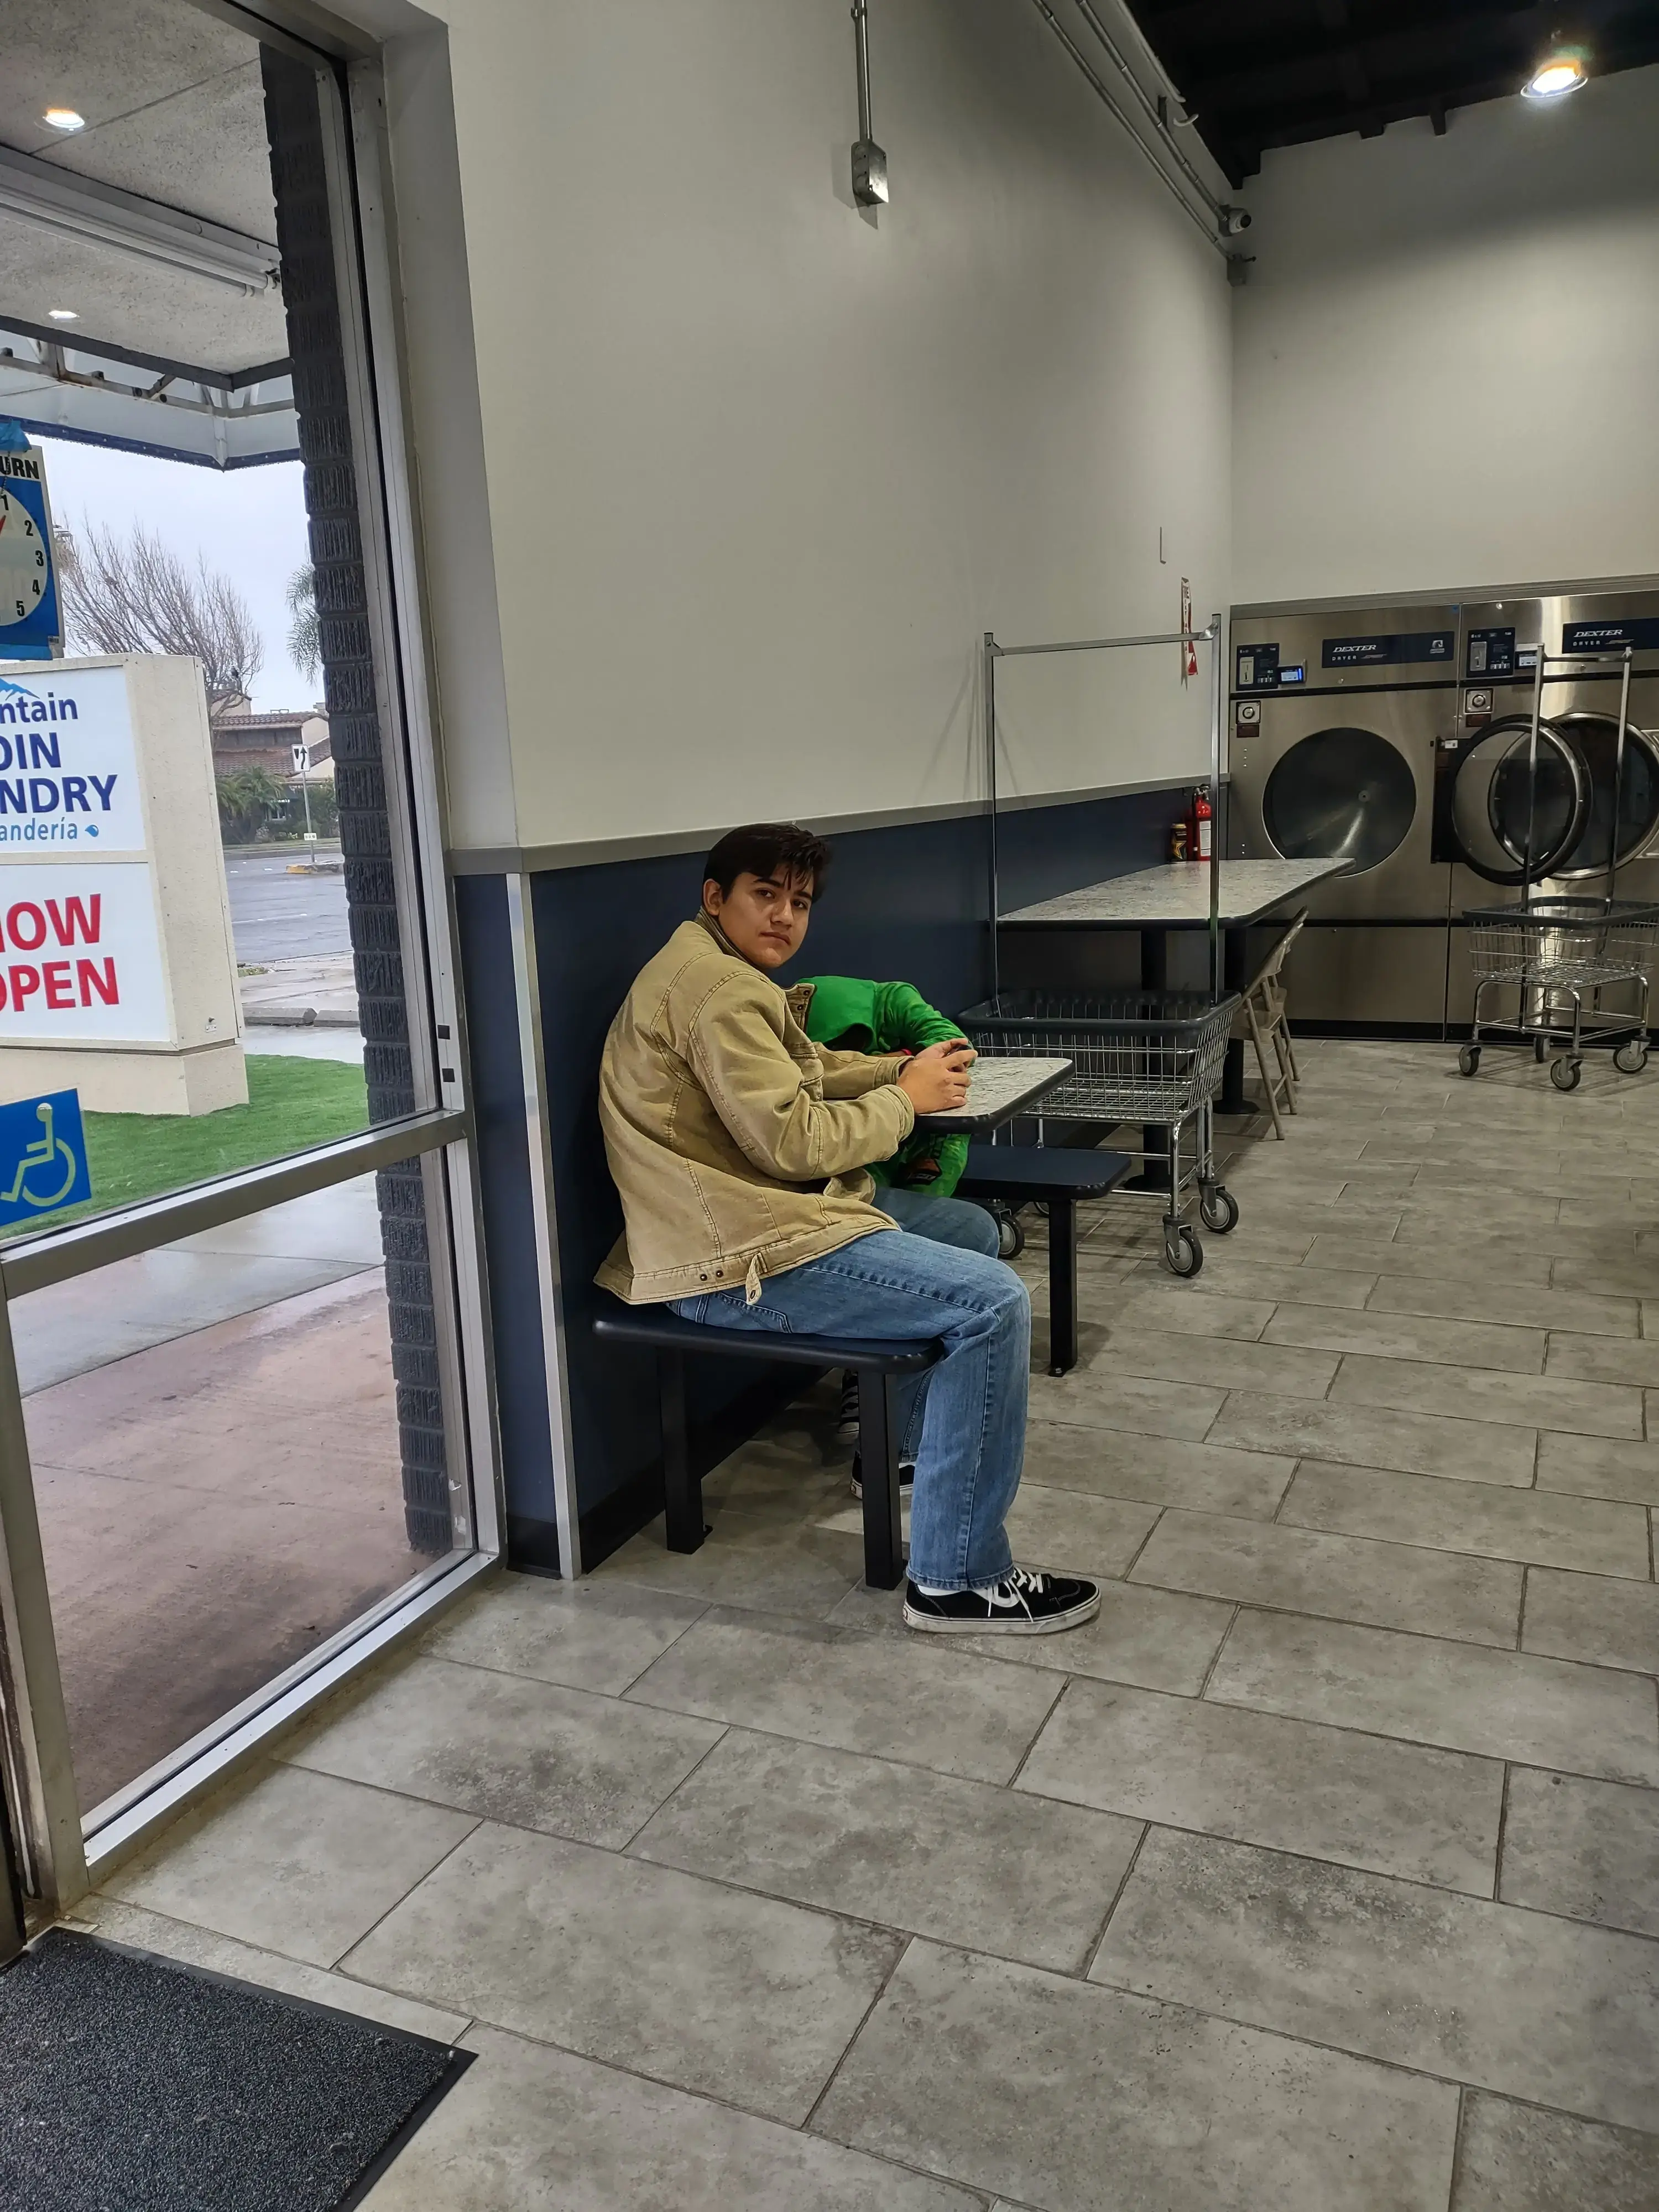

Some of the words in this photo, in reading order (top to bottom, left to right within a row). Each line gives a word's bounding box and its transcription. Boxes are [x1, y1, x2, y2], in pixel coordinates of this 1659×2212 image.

[0, 456, 39, 479] URN
[1, 494, 9, 511] 1
[24, 520, 34, 536] 2
[35, 550, 44, 567] 3
[32, 579, 40, 596] 4
[16, 600, 25, 617] 5
[1572, 629, 1623, 638] DEXTER
[1332, 644, 1377, 653] DEXTER
[0, 692, 78, 724] ntain
[0, 774, 118, 814] NDRY
[0, 893, 101, 953] OW
[0, 957, 119, 1012] PEN
